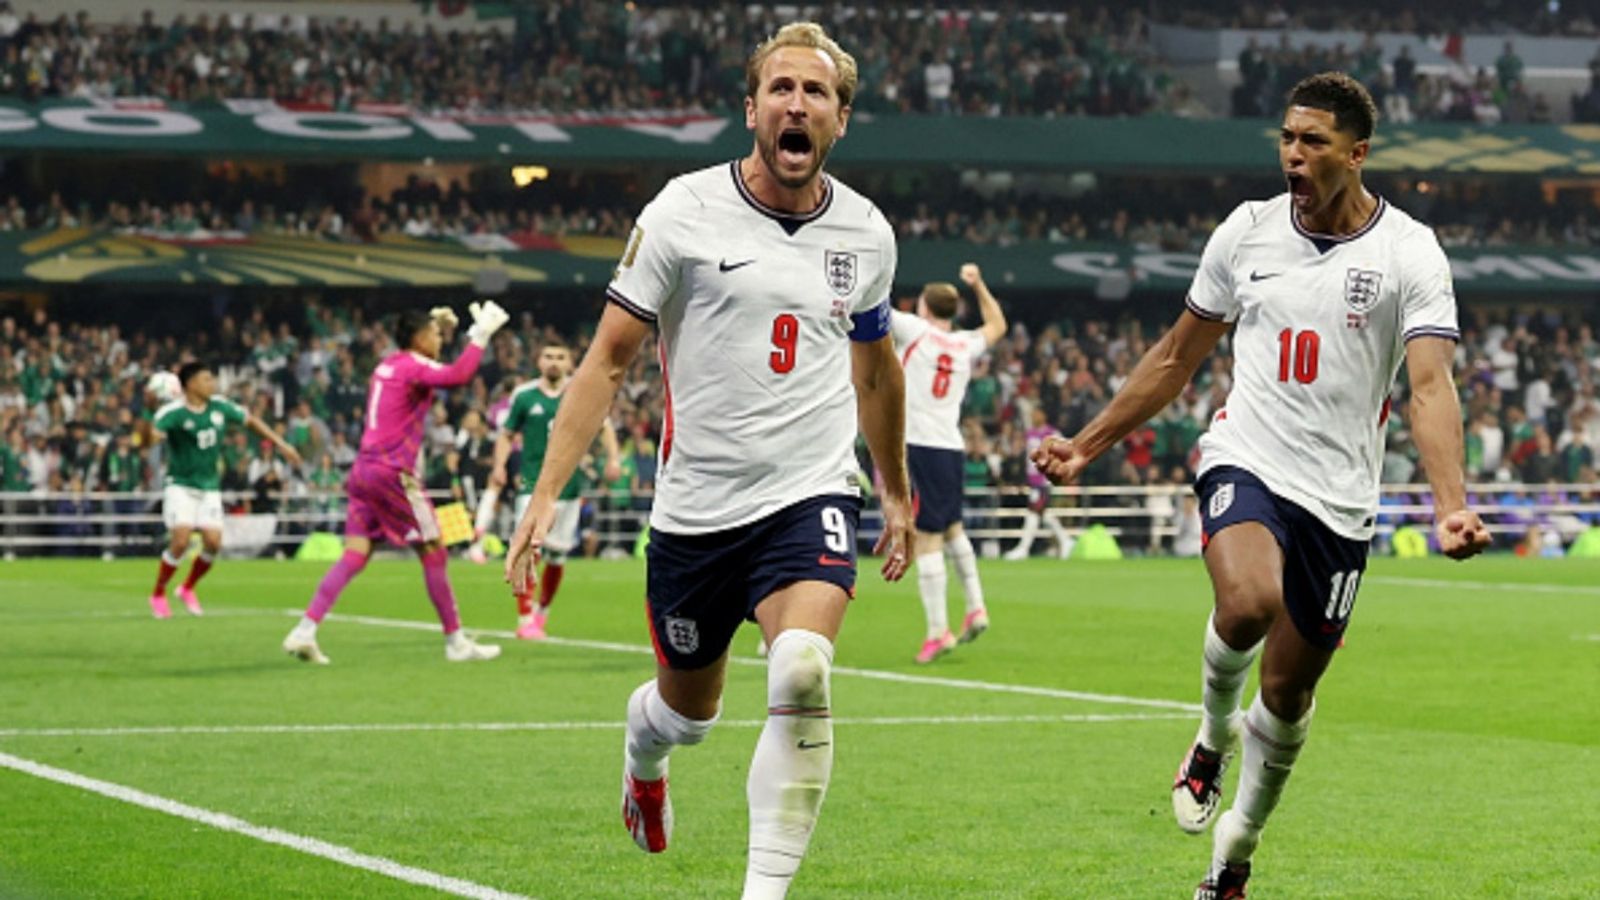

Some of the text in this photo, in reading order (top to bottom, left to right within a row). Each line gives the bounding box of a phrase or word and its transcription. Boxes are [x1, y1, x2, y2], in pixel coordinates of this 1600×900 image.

[0, 105, 204, 136] O
[769, 313, 799, 375] 9
[1277, 327, 1321, 385] 10
[820, 506, 849, 554] 9
[1324, 568, 1360, 621] 10
